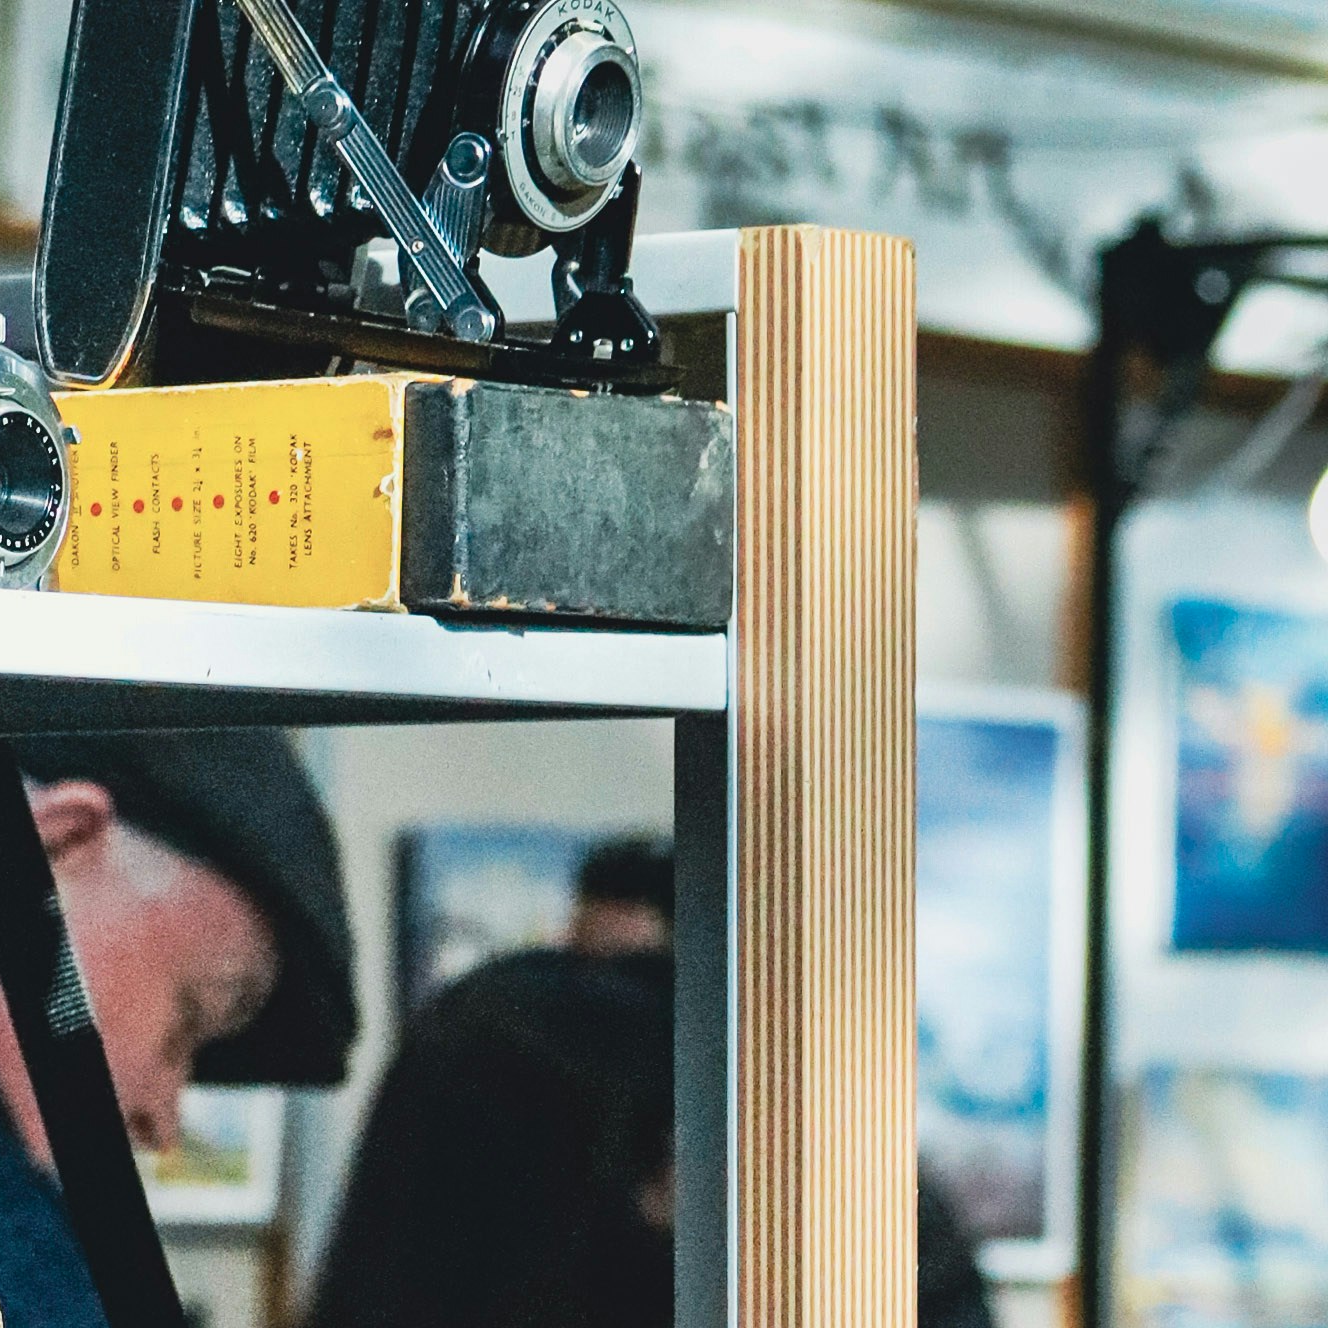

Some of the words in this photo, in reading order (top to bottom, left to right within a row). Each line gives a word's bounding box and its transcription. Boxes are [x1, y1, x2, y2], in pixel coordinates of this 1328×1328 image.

[558, 0, 615, 22] KODAK
[233, 435, 242, 453] ON
[247, 438, 256, 464] FILM
[109, 441, 119, 482] FINDER
[150, 453, 160, 514] CONTACTS
[233, 459, 243, 526] EXPOSURES
[289, 484, 299, 504] 320
[303, 441, 312, 522] ATTACHMENT
[110, 488, 119, 517] VIEW
[192, 499, 202, 525] SIZE
[110, 525, 120, 571] OPTICAL
[151, 521, 161, 554] FLASH
[248, 523, 257, 543] 620
[303, 529, 312, 556] LENS
[193, 531, 203, 579] PICTURE
[233, 533, 243, 568] EIGHT
[289, 534, 299, 569] TAKES
